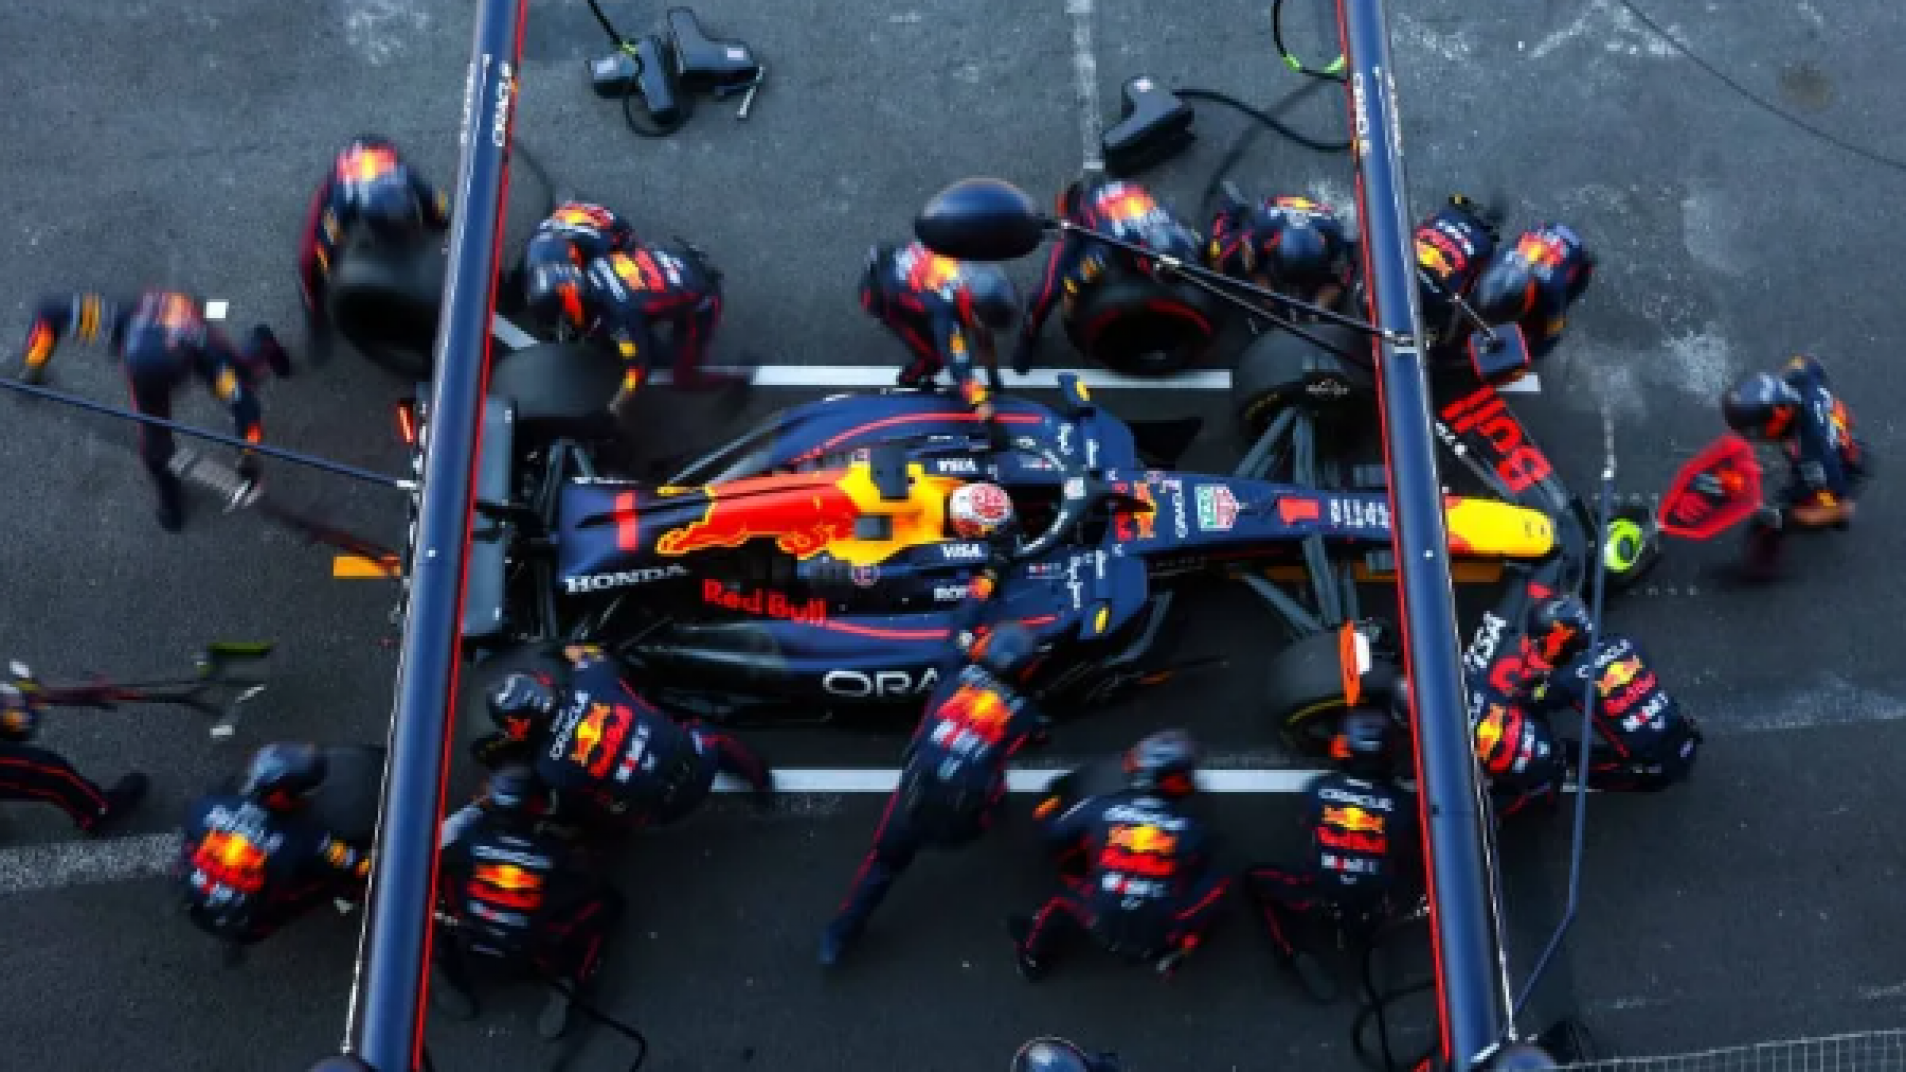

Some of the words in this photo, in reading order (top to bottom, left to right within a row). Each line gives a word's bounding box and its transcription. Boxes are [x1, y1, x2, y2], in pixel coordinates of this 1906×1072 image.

[1440, 384, 1553, 493] Bull
[941, 543, 986, 559] VISA
[563, 563, 688, 594] HONDA
[703, 579, 764, 614] Red
[768, 591, 828, 626] Bull
